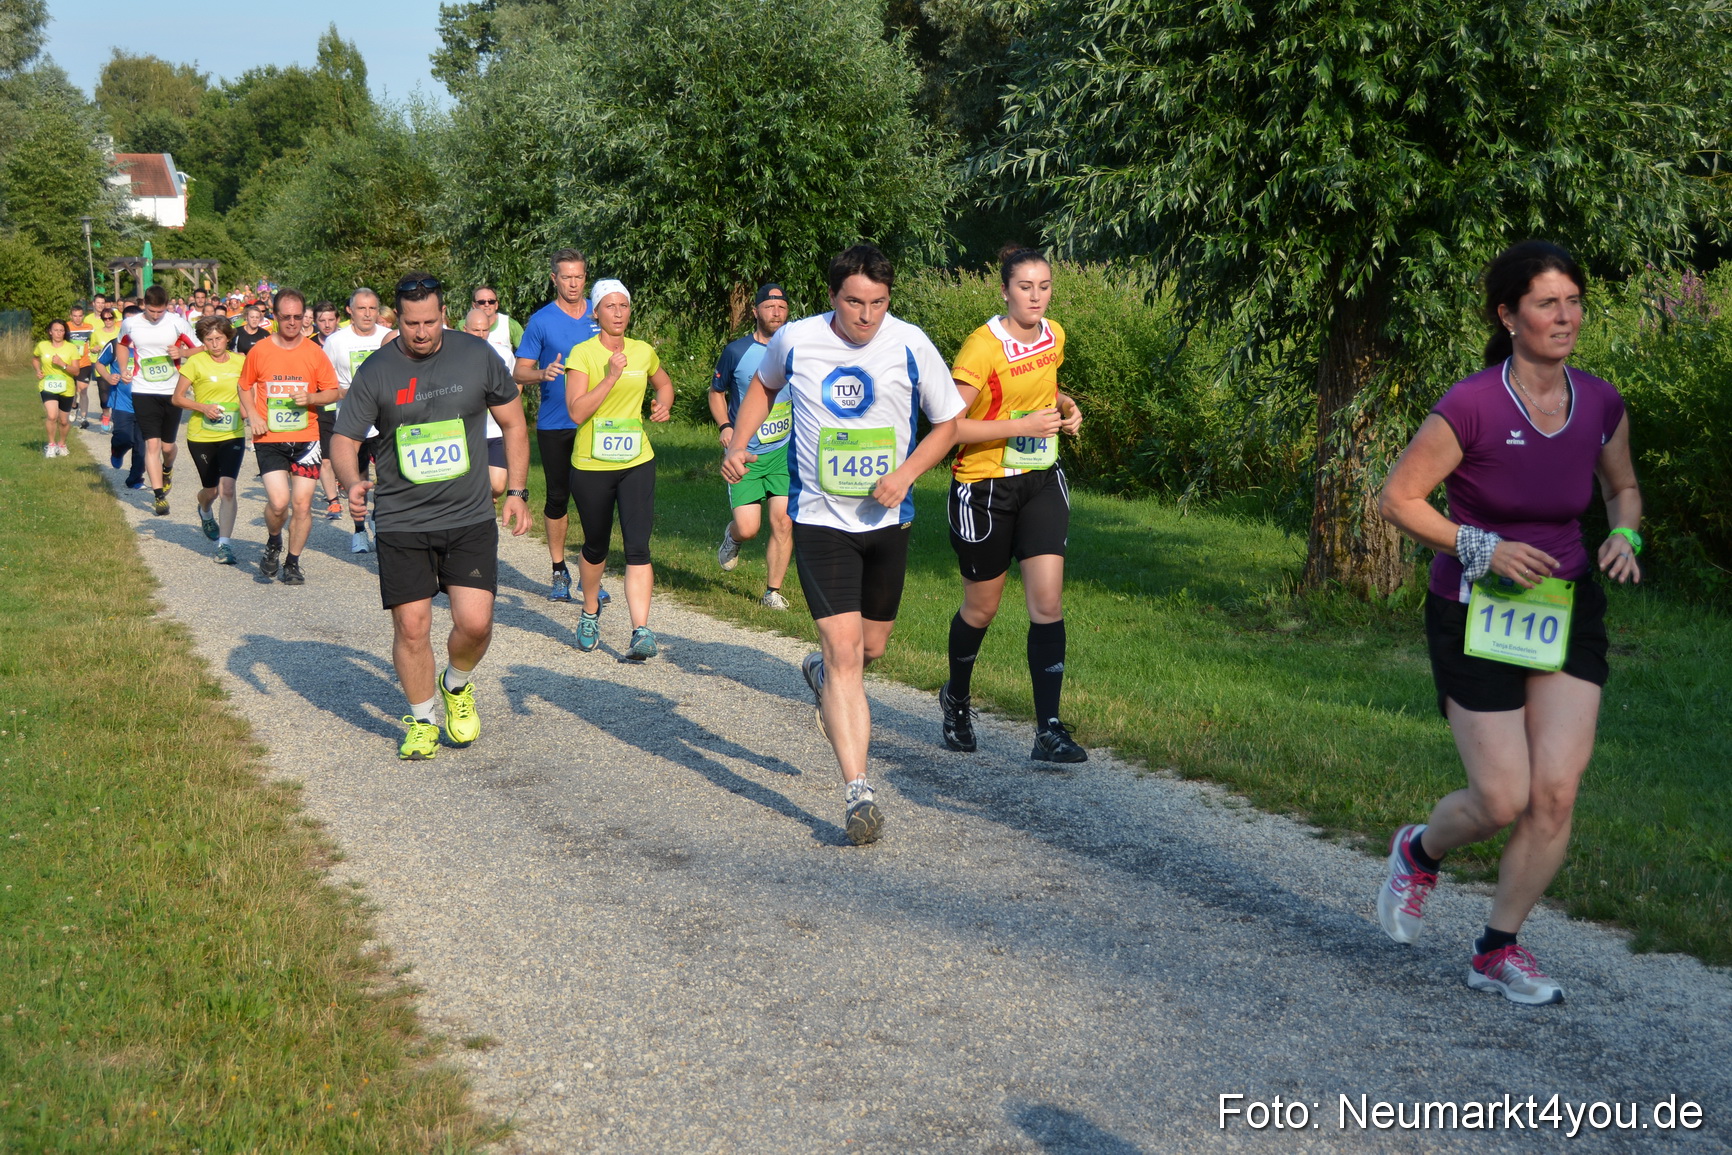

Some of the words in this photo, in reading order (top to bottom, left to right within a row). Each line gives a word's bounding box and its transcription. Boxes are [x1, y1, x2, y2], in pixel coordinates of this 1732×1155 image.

[149, 364, 168, 376] 830
[1010, 361, 1035, 377] MAX
[48, 381, 62, 389] 634
[415, 383, 463, 402] duerrer.de
[834, 384, 861, 397] TÜV
[841, 399, 856, 407] SÜD
[275, 411, 301, 423] 622
[760, 418, 790, 436] 6098
[603, 436, 633, 451] 670
[1015, 436, 1048, 453] 914
[406, 443, 461, 468] 1420
[827, 454, 889, 477] 1485
[1479, 603, 1559, 645] 1110
[1491, 640, 1509, 650] Tanja
[1508, 644, 1538, 655] Enderlein
